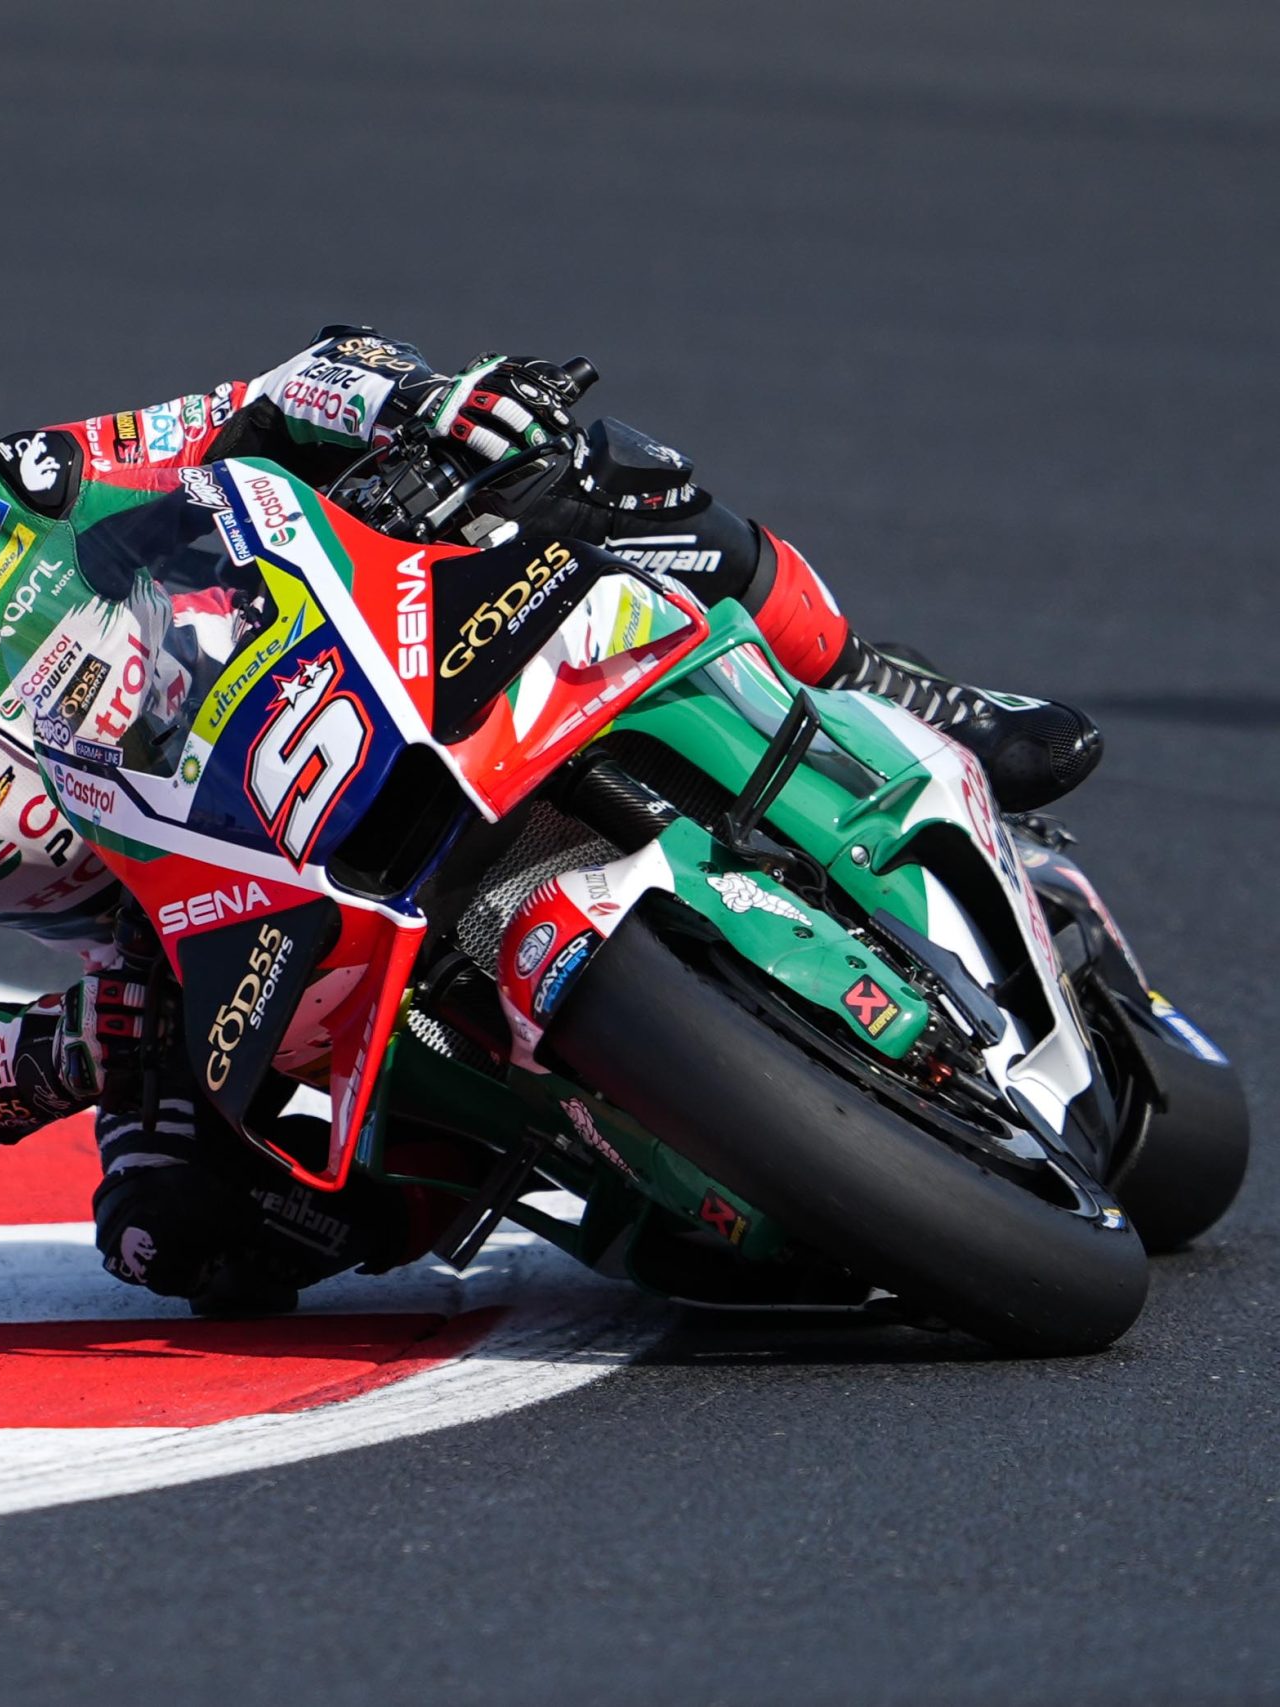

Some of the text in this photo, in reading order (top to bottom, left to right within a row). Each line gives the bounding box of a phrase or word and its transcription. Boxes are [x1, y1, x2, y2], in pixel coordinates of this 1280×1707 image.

[245, 476, 289, 530] Castrol
[51, 568, 75, 597] Moto
[396, 550, 429, 680] SENA
[507, 558, 580, 636] SPORTS
[21, 633, 73, 697] Castrol
[31, 641, 84, 709] POWER1
[61, 660, 102, 718] OD55
[209, 638, 283, 728] ultimate
[65, 772, 116, 814] Castrol
[158, 881, 272, 935] SENA
[249, 935, 294, 1031] SPORTS
[534, 936, 589, 1013] DAYCO
